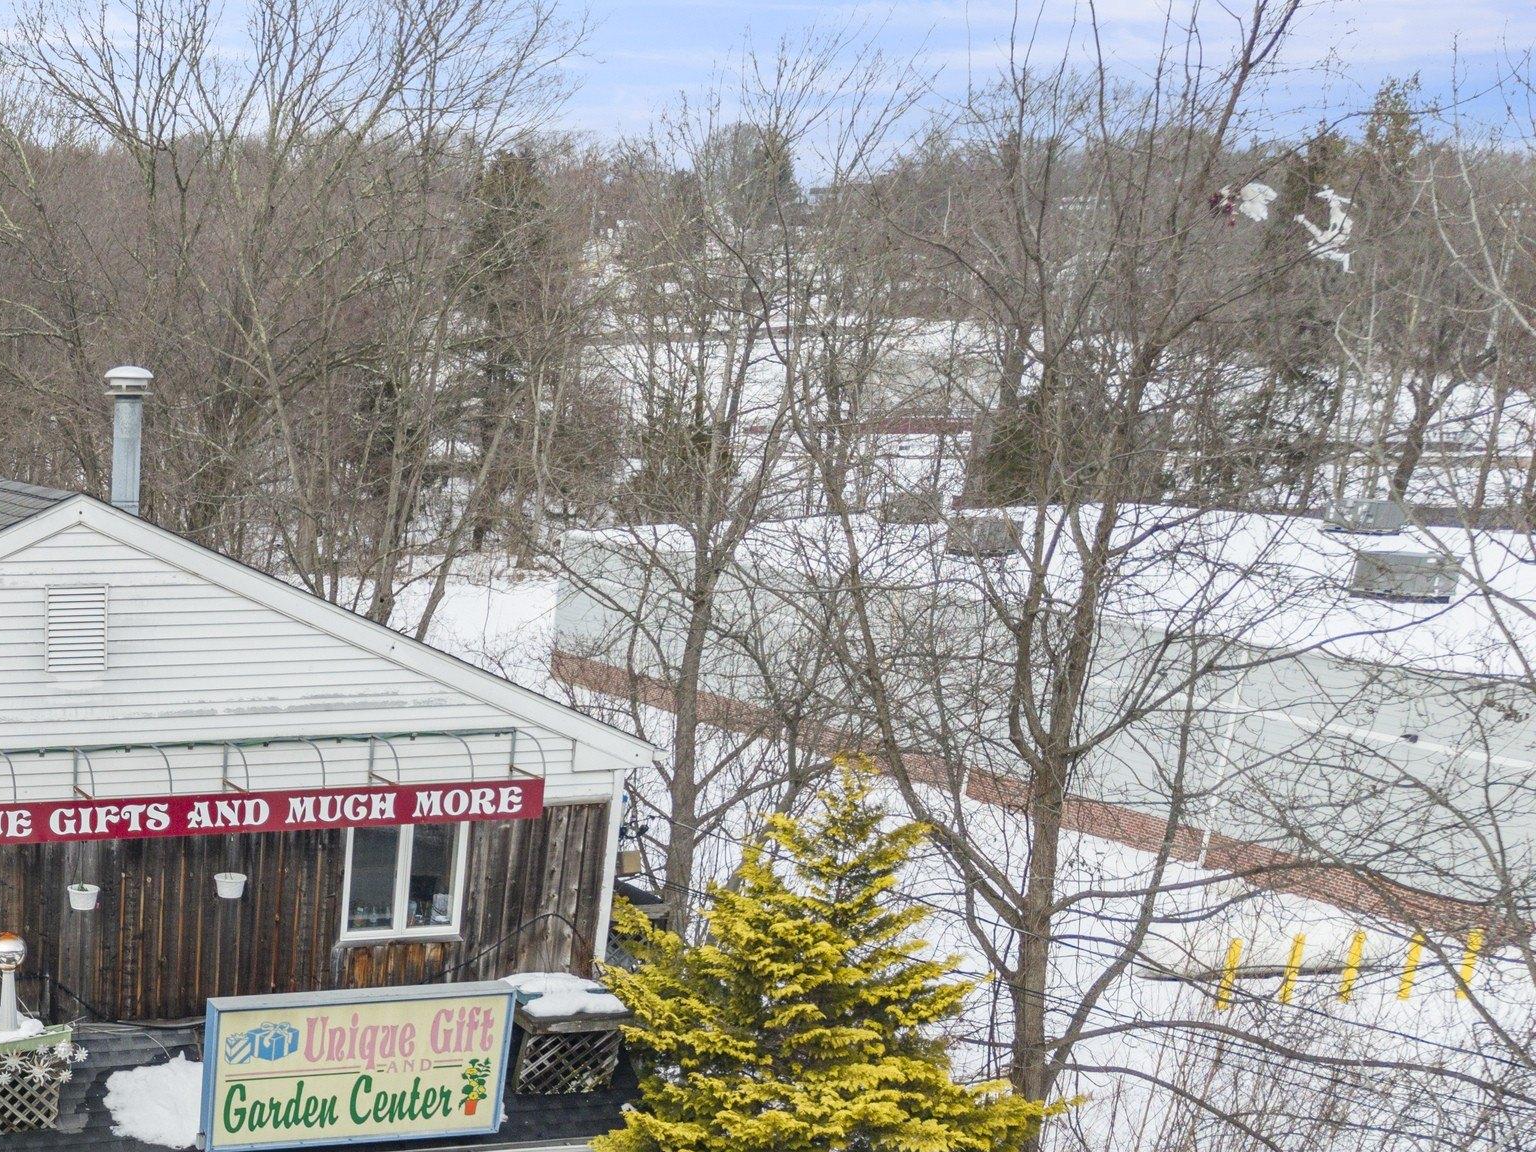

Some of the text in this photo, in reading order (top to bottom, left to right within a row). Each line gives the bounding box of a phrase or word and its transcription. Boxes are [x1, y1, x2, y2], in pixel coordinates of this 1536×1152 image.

[49, 802, 171, 835] GIFTS
[187, 797, 270, 829] AND
[284, 791, 396, 824] MUCH
[412, 785, 523, 818] MORE
[303, 1005, 495, 1070] Unique Gift
[386, 1059, 433, 1073] AND
[223, 1074, 453, 1134] Garden Center
